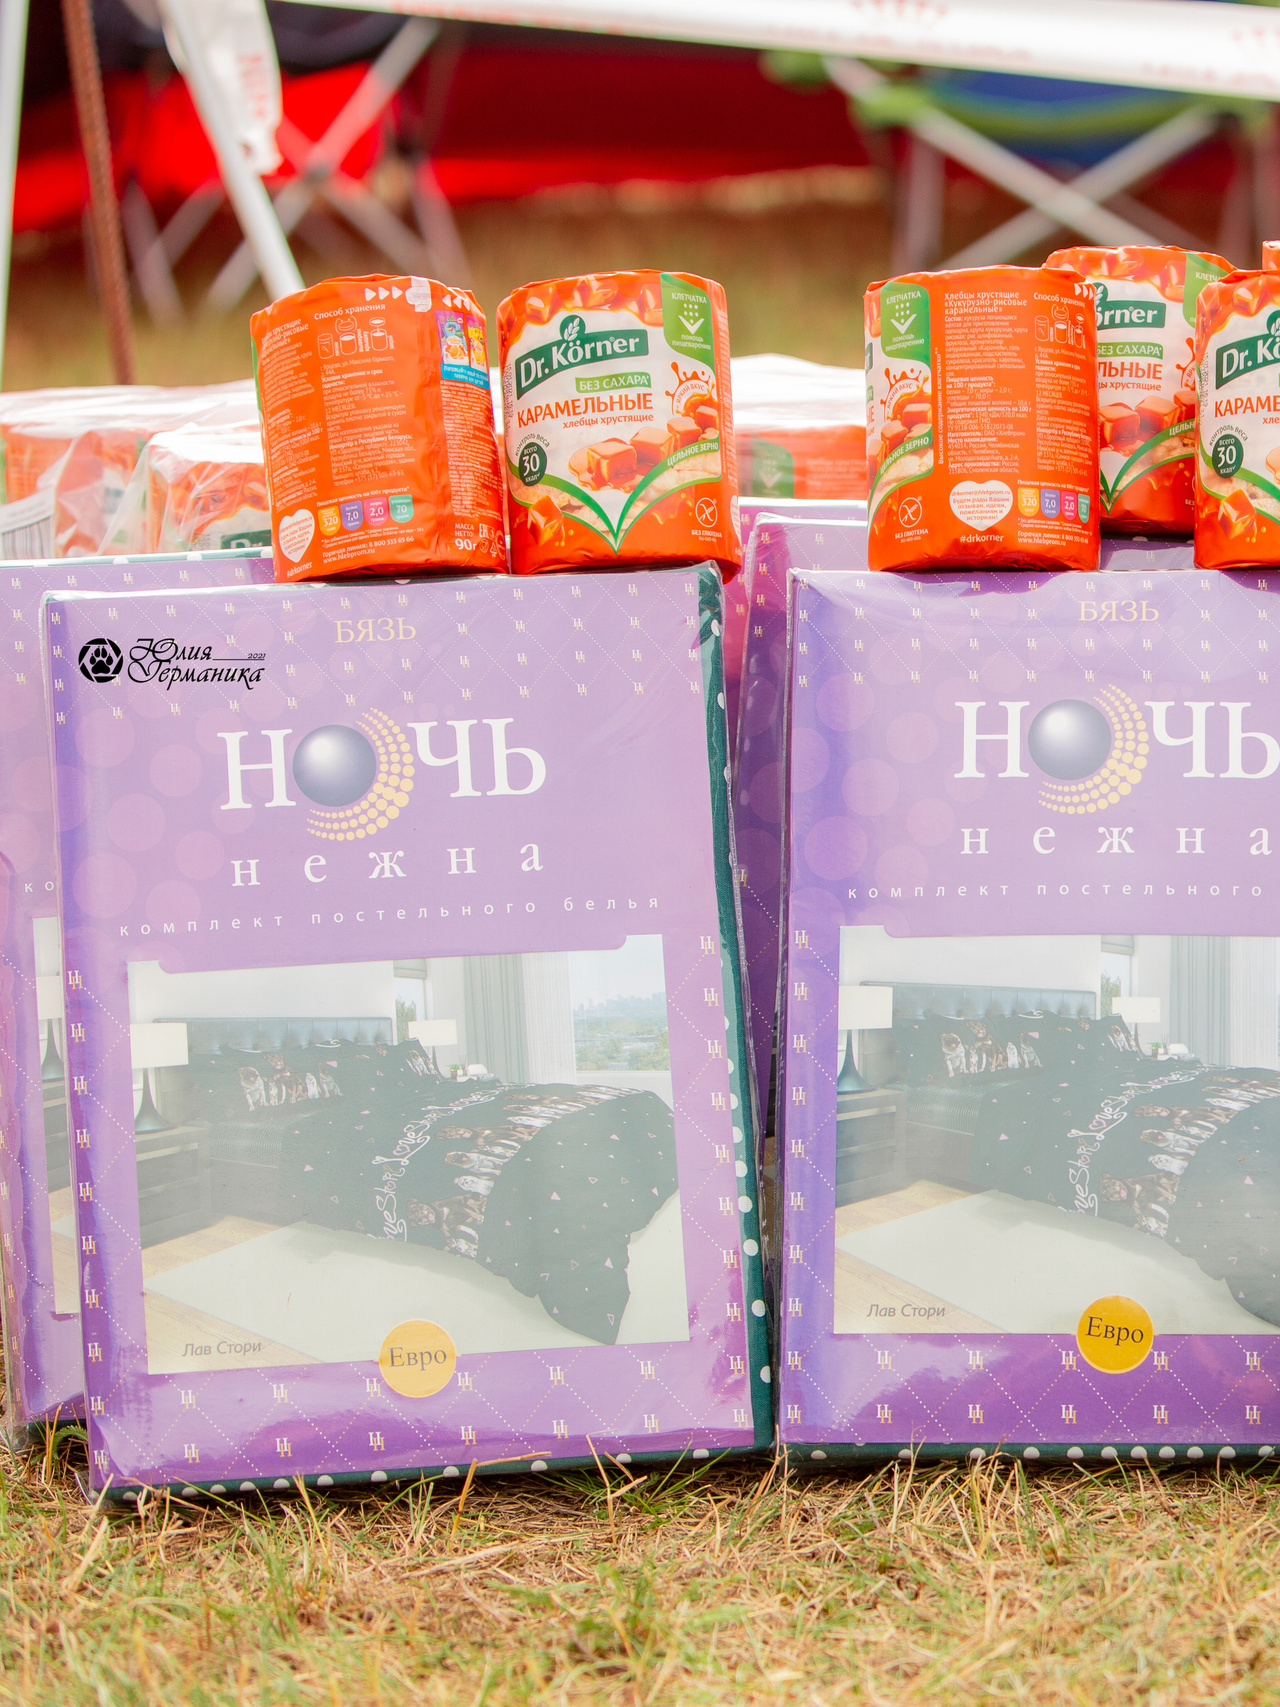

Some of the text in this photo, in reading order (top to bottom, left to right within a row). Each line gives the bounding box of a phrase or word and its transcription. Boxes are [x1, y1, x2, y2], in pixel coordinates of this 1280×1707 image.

[671, 292, 708, 304] КЛЕТЧАТКА
[886, 290, 922, 305] КЛЕТЧАТКА
[944, 290, 1020, 300] Хлебцы хрустящие
[1033, 292, 1060, 302] Способ
[314, 303, 386, 320] Способ хранения
[944, 306, 1003, 316] карамельные»
[520, 335, 640, 388] Dr. Körner
[1222, 348, 1253, 378] Dr.
[579, 380, 601, 391] БЕЗ
[690, 384, 705, 393] ВКУС
[1108, 380, 1162, 392] хрустящие
[517, 392, 654, 429] КАРАМЕЛЬНЫЕ
[562, 414, 654, 430] хлебцы хрустящие
[667, 442, 719, 466] ЦЕЛЬНОЕ ЗЕРНО
[880, 436, 930, 475] ЦЕЛЬНОЕ ЗЕРНО
[1216, 445, 1237, 468] 30
[522, 453, 540, 473] 30
[396, 505, 407, 513] 70
[1021, 498, 1037, 507] 320
[1045, 499, 1056, 509] 7,0
[1064, 501, 1075, 511] 2,0
[346, 511, 359, 521] 7,0
[370, 507, 384, 517] 2,0
[323, 516, 338, 527] 320
[960, 534, 1004, 543] #drkorner
[1017, 537, 1066, 546] www.hlebprom.ru
[1077, 600, 1160, 623] БЯЗЬ
[334, 618, 418, 645] БЯЗЬ
[960, 825, 1274, 856] нежна
[230, 841, 544, 889] нежна
[847, 882, 1010, 900] комплект
[1036, 880, 1262, 900] постельного
[119, 896, 661, 938] комплект постельного белья
[866, 1302, 946, 1321] Лав Стори
[1085, 1315, 1146, 1347] Евро
[182, 1338, 263, 1358] Лав Стори
[387, 1345, 449, 1374] Евро
